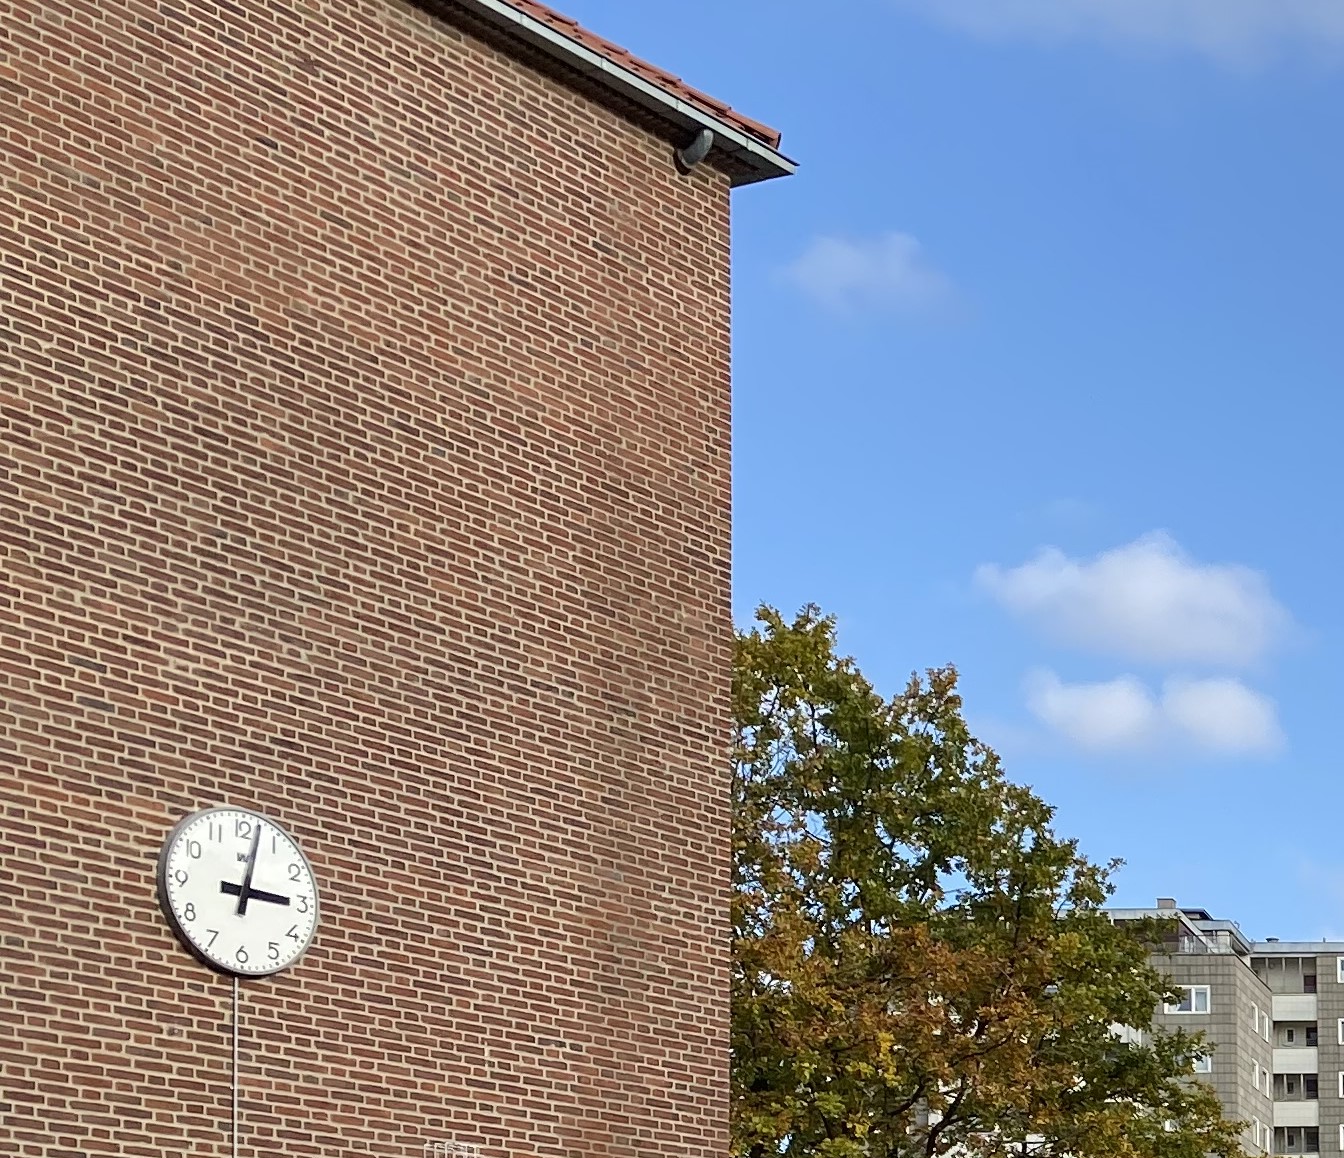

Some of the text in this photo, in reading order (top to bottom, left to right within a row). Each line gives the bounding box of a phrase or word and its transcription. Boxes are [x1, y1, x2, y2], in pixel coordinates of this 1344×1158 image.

[209, 822, 222, 843] 11
[235, 819, 251, 840] 12
[186, 839, 202, 859] 10
[272, 836, 276, 854] 1
[175, 869, 188, 887] 9
[288, 863, 301, 882] 2
[184, 903, 196, 921] 8
[296, 895, 308, 913] 3
[206, 929, 219, 947] 7
[285, 925, 299, 942] 4
[236, 945, 249, 964] 6
[267, 942, 279, 960] 5
